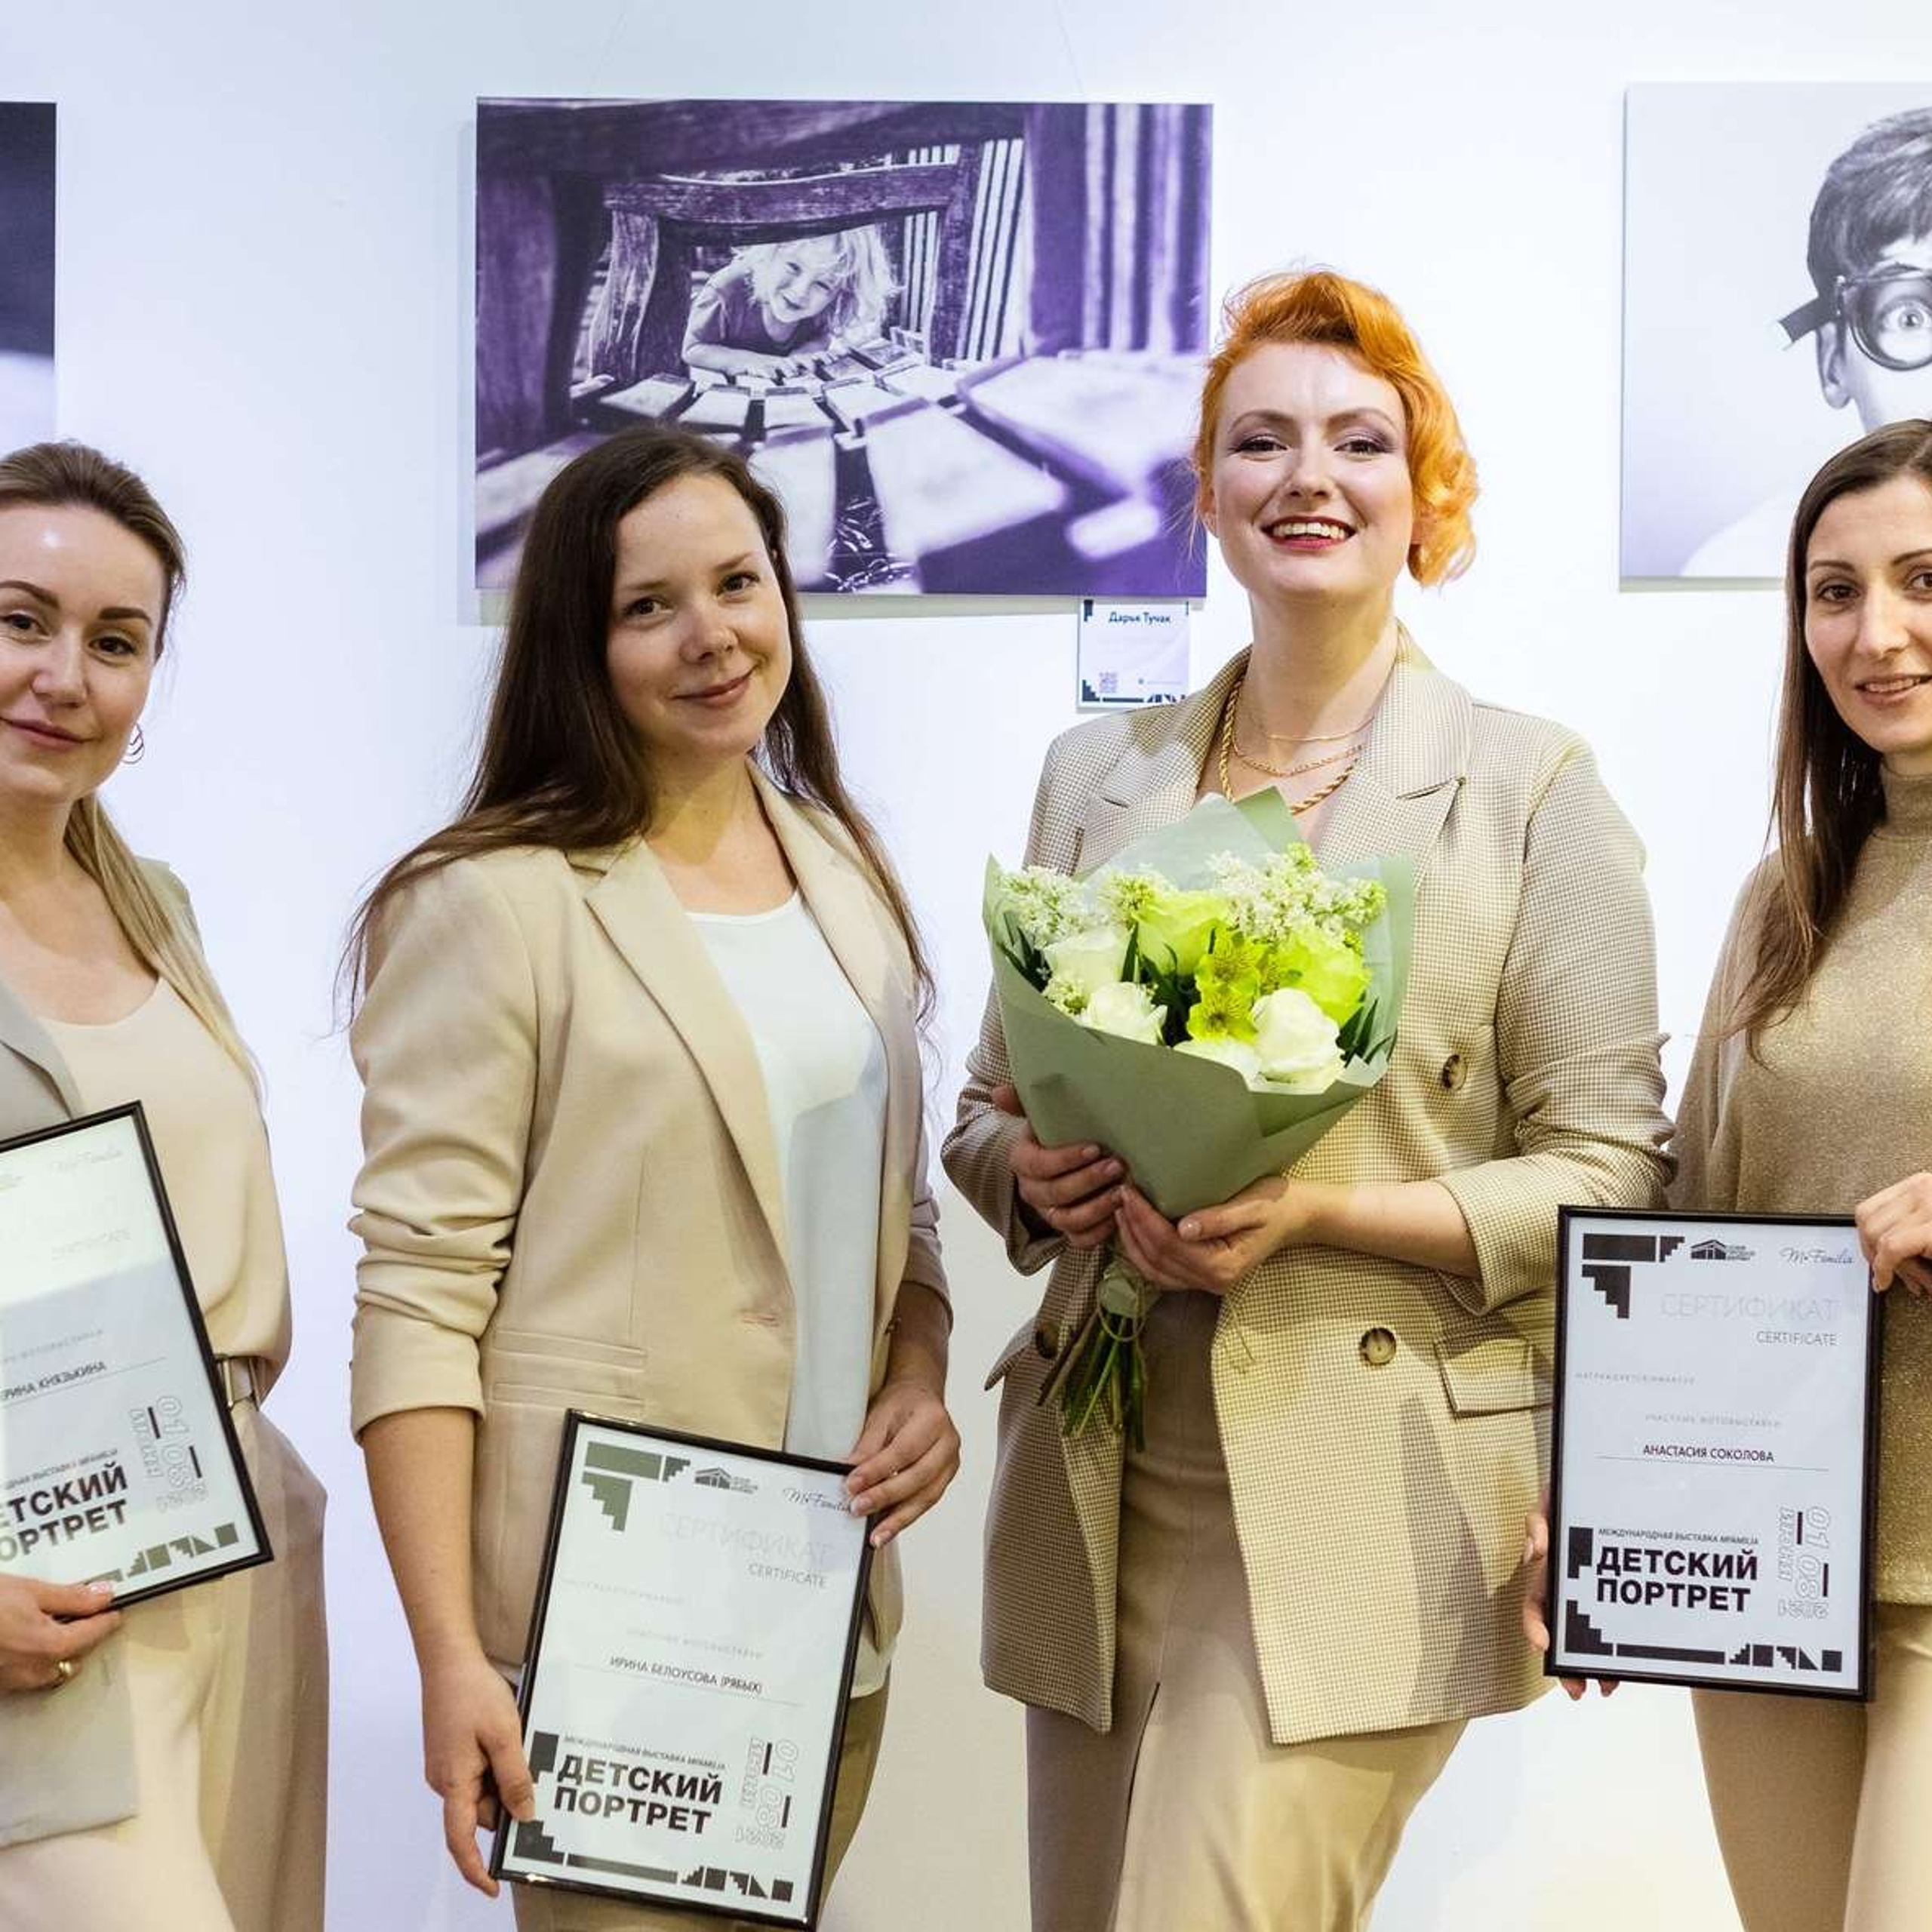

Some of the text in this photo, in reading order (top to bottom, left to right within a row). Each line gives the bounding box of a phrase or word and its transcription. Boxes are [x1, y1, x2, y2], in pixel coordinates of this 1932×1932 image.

[1660, 1293, 1840, 1320] СЕРТИФИКАТ
[1755, 1331, 1837, 1346] CERTIFICATE
[1643, 1444, 1774, 1463] АНАСТАСИЯ СОКОЛОВА
[1598, 1528, 1673, 1540] МЕЖДУНАРОДНАЯ
[1675, 1531, 1718, 1543] ВЫСТАВКА
[747, 1563, 828, 1589] CERTIFICATE
[1596, 1546, 1758, 1581] ДЕТСКИЙ
[1596, 1578, 1751, 1613] ПОРТРЕТ
[609, 1655, 648, 1673] ИРИНА
[651, 1661, 717, 1686] БЕЛОУСОВА
[557, 1754, 723, 1805] ДЕТСКИЙ
[554, 1786, 712, 1835] ПОРТРЕТ
